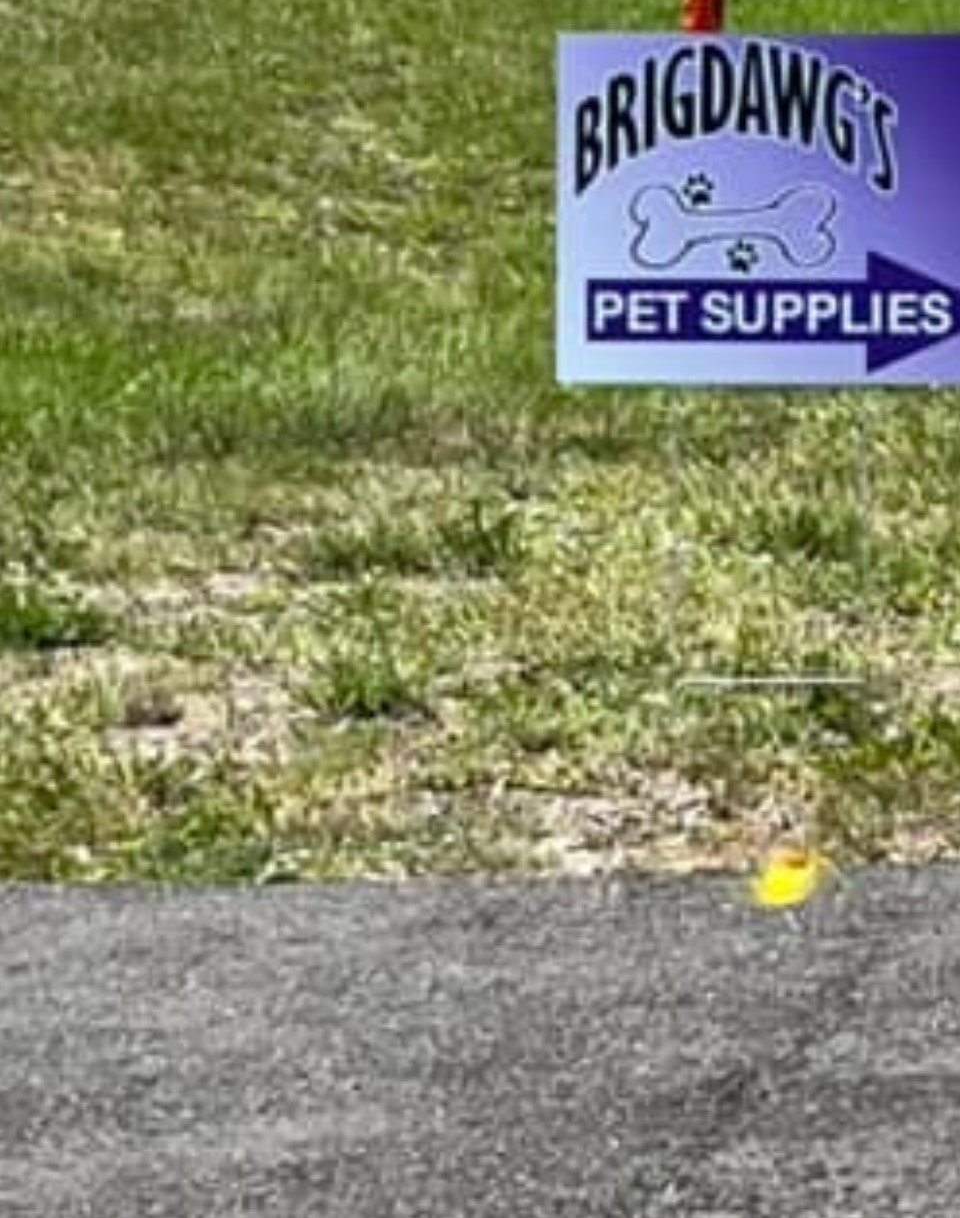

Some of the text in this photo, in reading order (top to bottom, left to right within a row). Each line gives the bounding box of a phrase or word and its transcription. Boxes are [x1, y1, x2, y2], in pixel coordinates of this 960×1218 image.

[575, 40, 896, 195] BRIGDAWG'S
[593, 290, 954, 335] PET SUPPLIES
